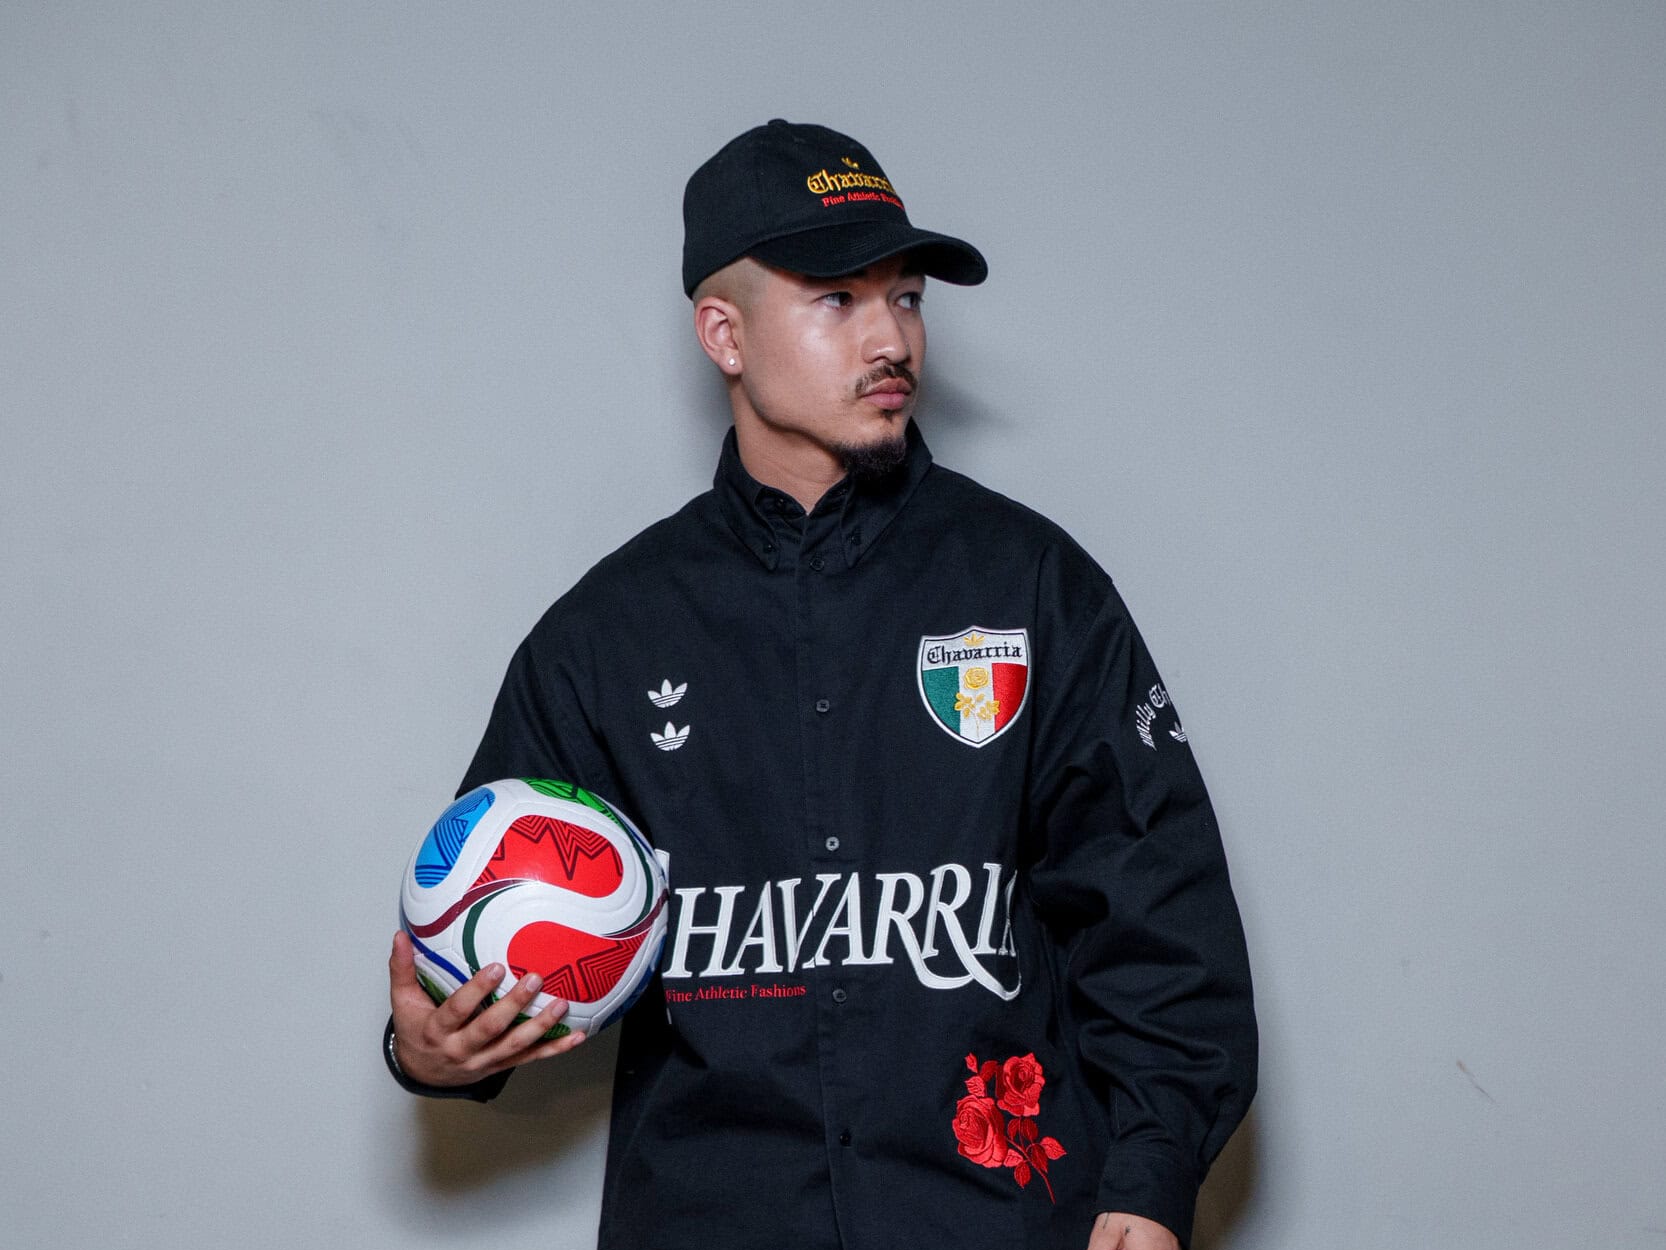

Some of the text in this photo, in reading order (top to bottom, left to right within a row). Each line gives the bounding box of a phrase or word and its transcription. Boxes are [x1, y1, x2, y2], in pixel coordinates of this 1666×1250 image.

[807, 169, 896, 194] Chavarr
[821, 195, 846, 208] Fine
[927, 641, 1023, 665] Chavarria
[655, 849, 1020, 1001] HAVARRI
[664, 983, 807, 1003] Fine Athletic Fashions
